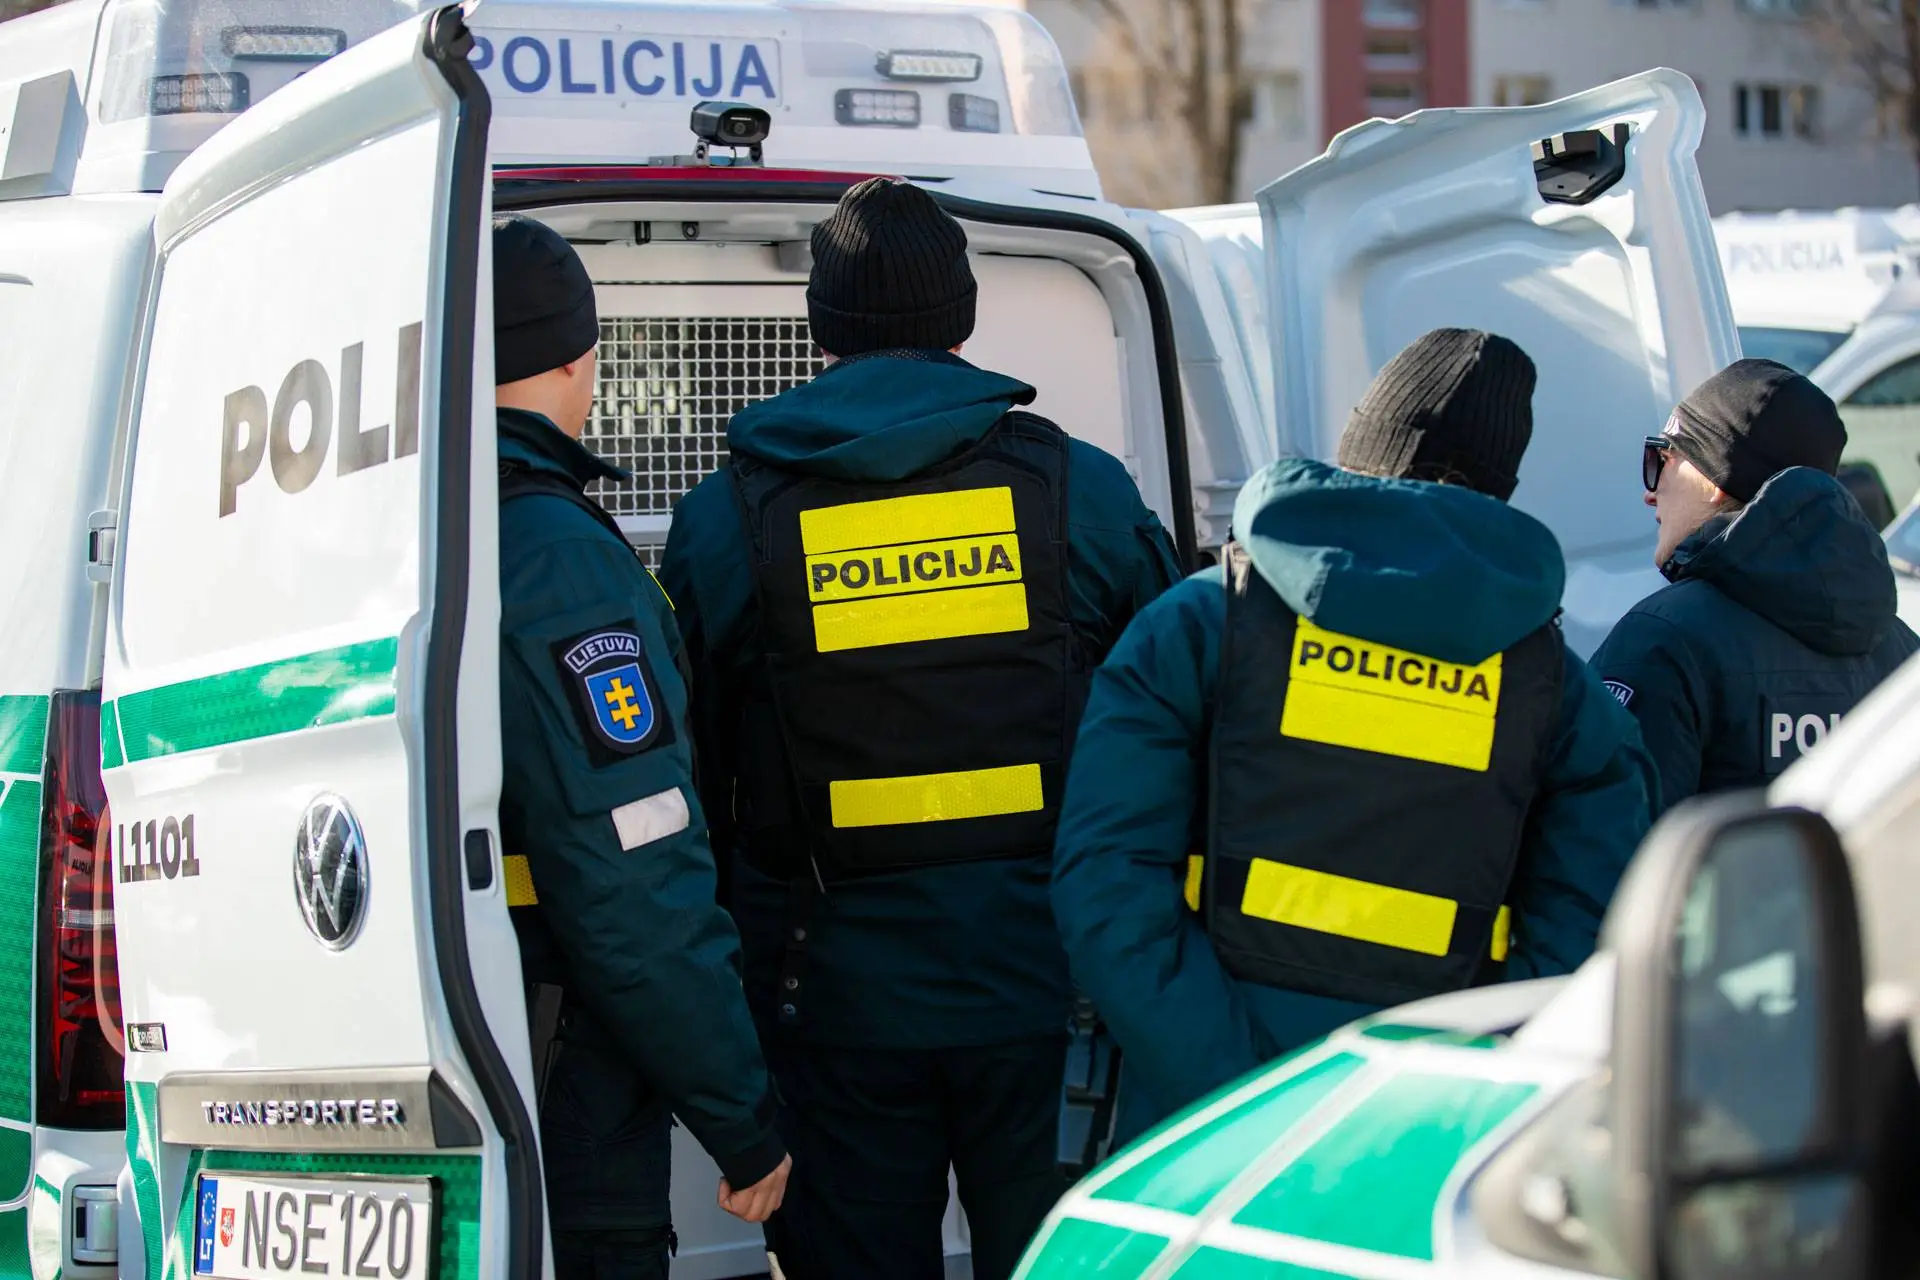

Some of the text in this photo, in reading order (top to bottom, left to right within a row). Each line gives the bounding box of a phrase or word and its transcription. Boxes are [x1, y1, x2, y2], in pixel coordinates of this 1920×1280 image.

[219, 320, 422, 518] POLI
[811, 544, 1015, 593] POLICIJA
[571, 637, 636, 667] LIETUVA
[1299, 640, 1491, 702] POLICIJA
[118, 814, 200, 883] L1101
[201, 1099, 405, 1126] TRANSPORTER
[242, 1189, 414, 1280] NSE120
